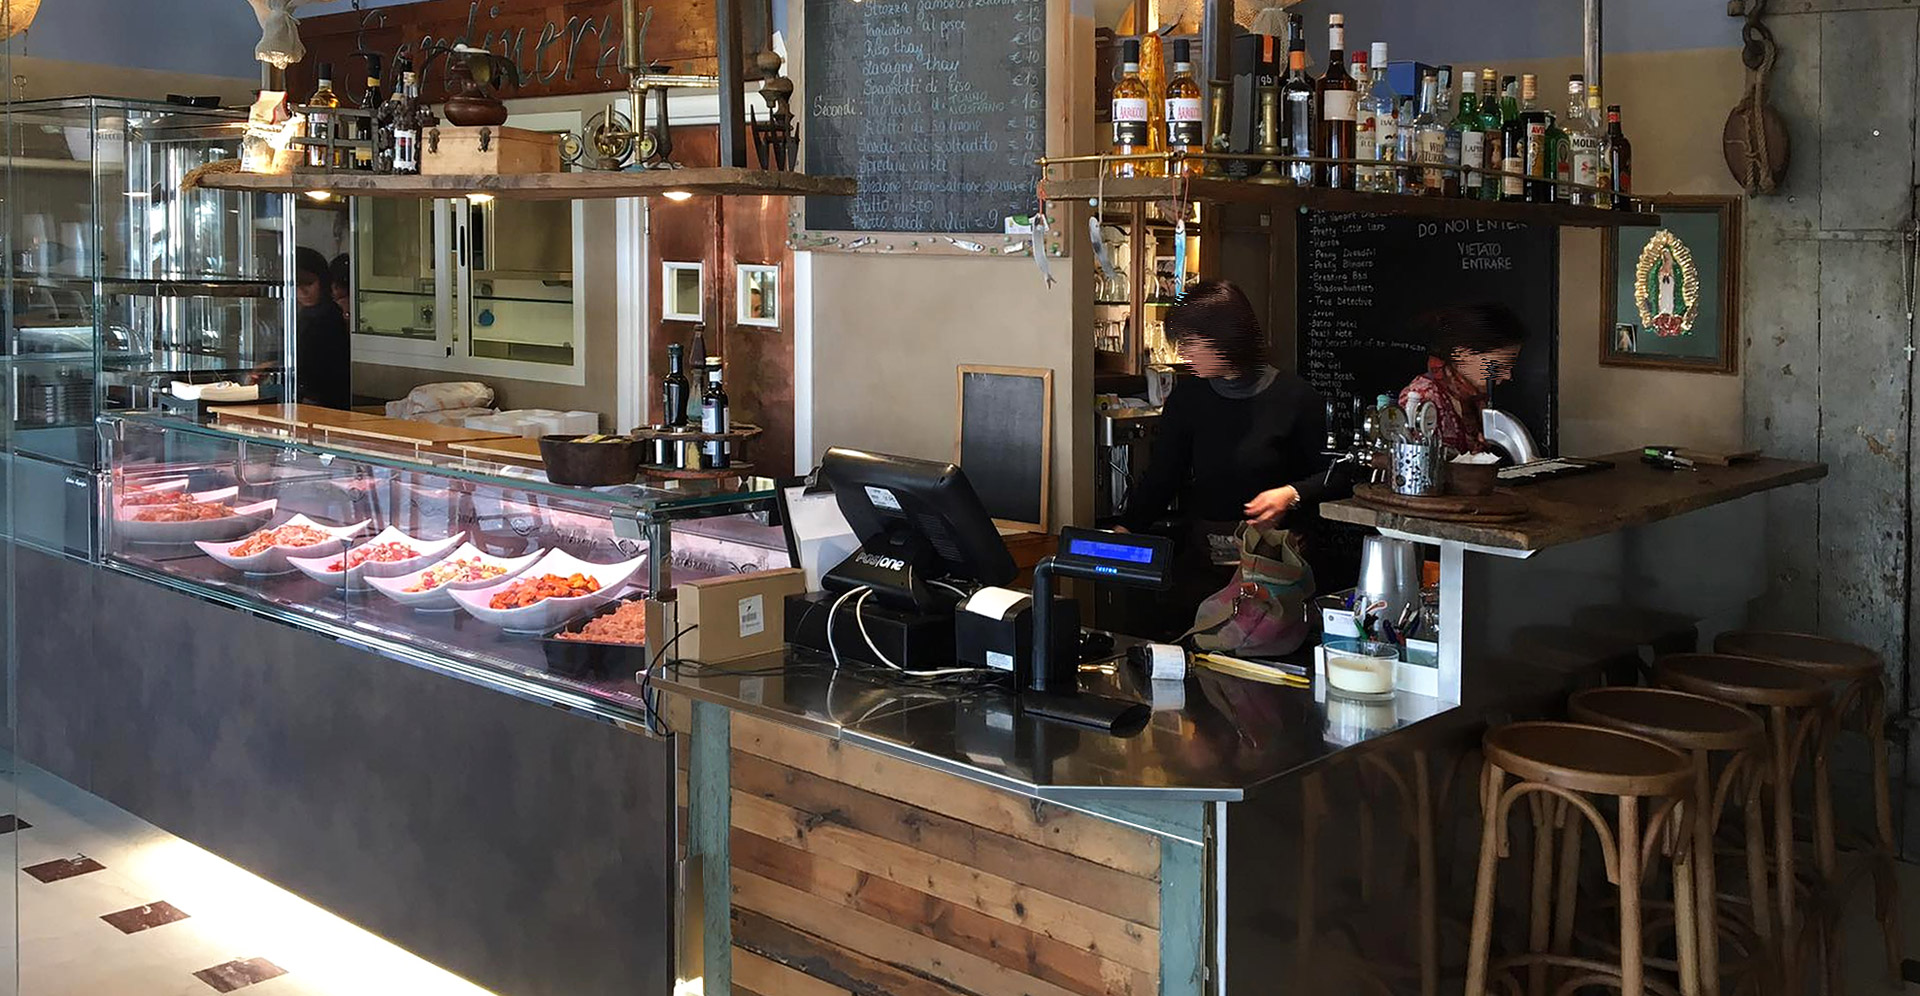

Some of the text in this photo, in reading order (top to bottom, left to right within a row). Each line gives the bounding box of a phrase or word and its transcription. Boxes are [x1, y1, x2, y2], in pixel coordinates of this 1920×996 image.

[922, 14, 935, 31] al
[941, 19, 966, 40] pesce
[864, 39, 890, 58] Riso
[894, 37, 924, 61] thay
[863, 59, 913, 85] Lasagne
[922, 54, 959, 83] thay
[864, 77, 922, 105] Spaghetti
[925, 75, 938, 93] di
[986, 208, 998, 229] 9
[1418, 223, 1437, 238] DO
[1457, 242, 1501, 256] VIETATO
[1462, 256, 1512, 270] ENTRARE
[1315, 295, 1373, 306] True Detective
